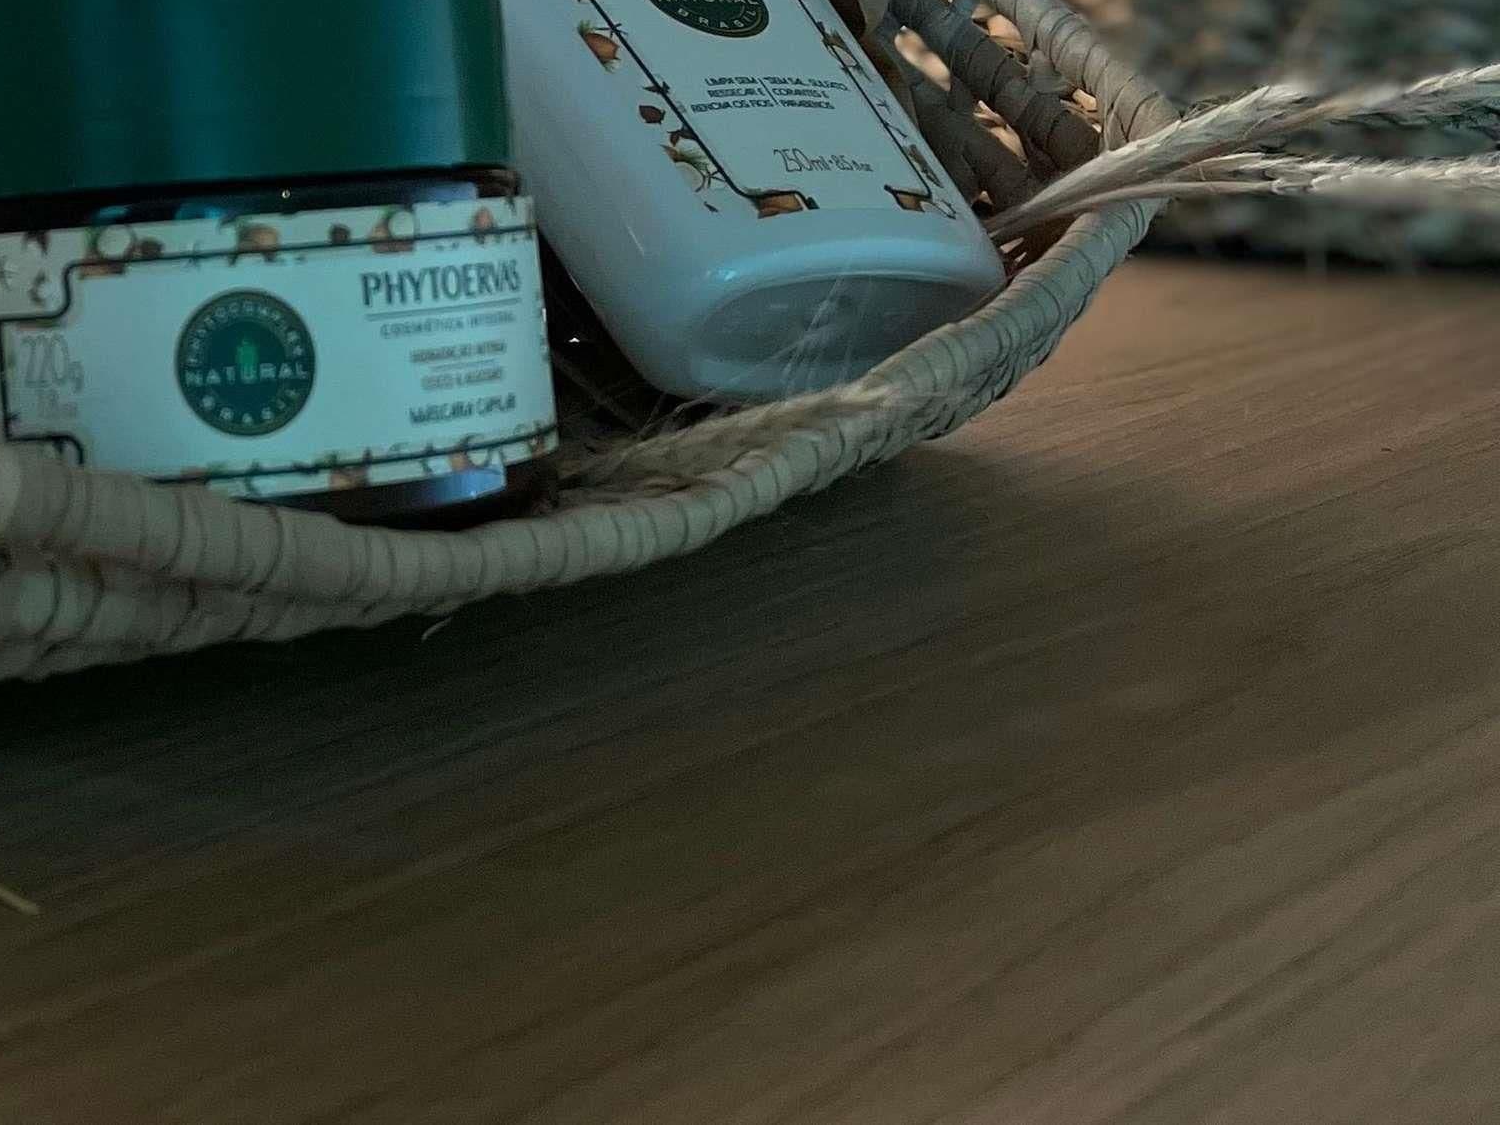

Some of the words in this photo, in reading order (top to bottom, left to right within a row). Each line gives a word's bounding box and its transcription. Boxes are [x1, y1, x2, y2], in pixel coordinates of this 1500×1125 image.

[677, 7, 758, 29] BRASIL
[360, 259, 521, 307] PHYTOERVAS
[185, 361, 309, 387] NATURAL
